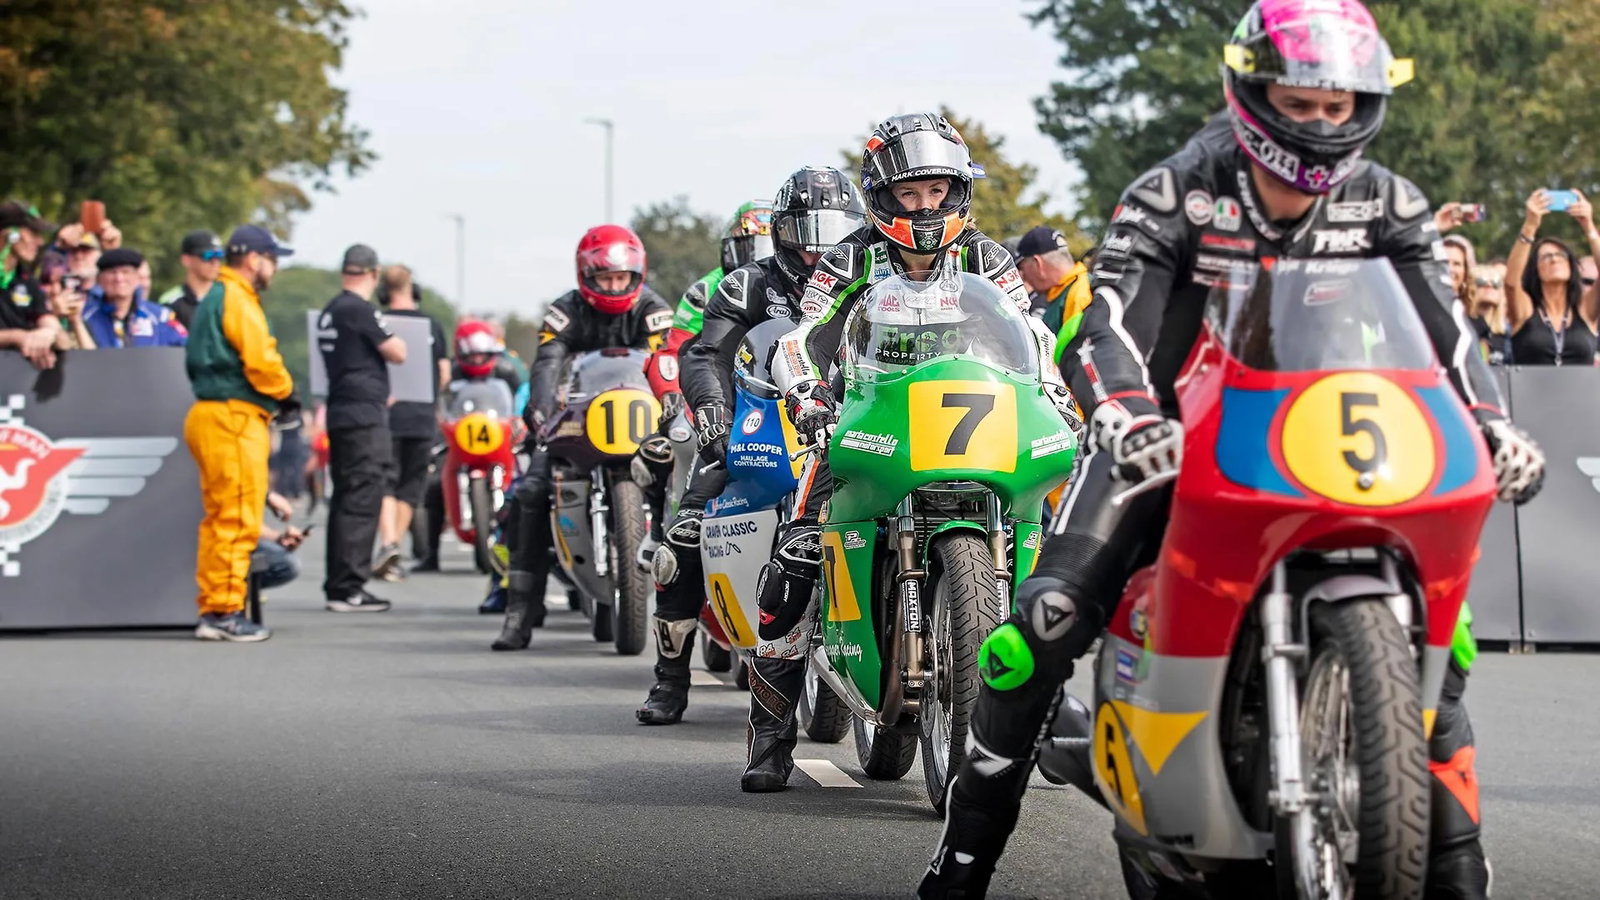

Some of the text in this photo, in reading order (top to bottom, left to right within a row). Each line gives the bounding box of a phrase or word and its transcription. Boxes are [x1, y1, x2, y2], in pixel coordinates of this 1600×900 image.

[891, 167, 959, 182] MARK COVERDALE
[812, 270, 836, 288] NGK
[996, 269, 1020, 289] NGK
[769, 307, 789, 316] Arai
[875, 346, 942, 361] PROPERTY
[599, 399, 652, 445] 10
[746, 417, 760, 428] 110
[941, 392, 996, 456] 7
[467, 423, 491, 449] 14
[1340, 391, 1388, 475] 5
[730, 442, 783, 456] M&L COOPER
[733, 460, 778, 468] CONTRACTORS
[721, 520, 758, 538] CLASSIC
[824, 545, 837, 609] 7
[714, 580, 740, 642] 8
[907, 581, 919, 631] MAXTON
